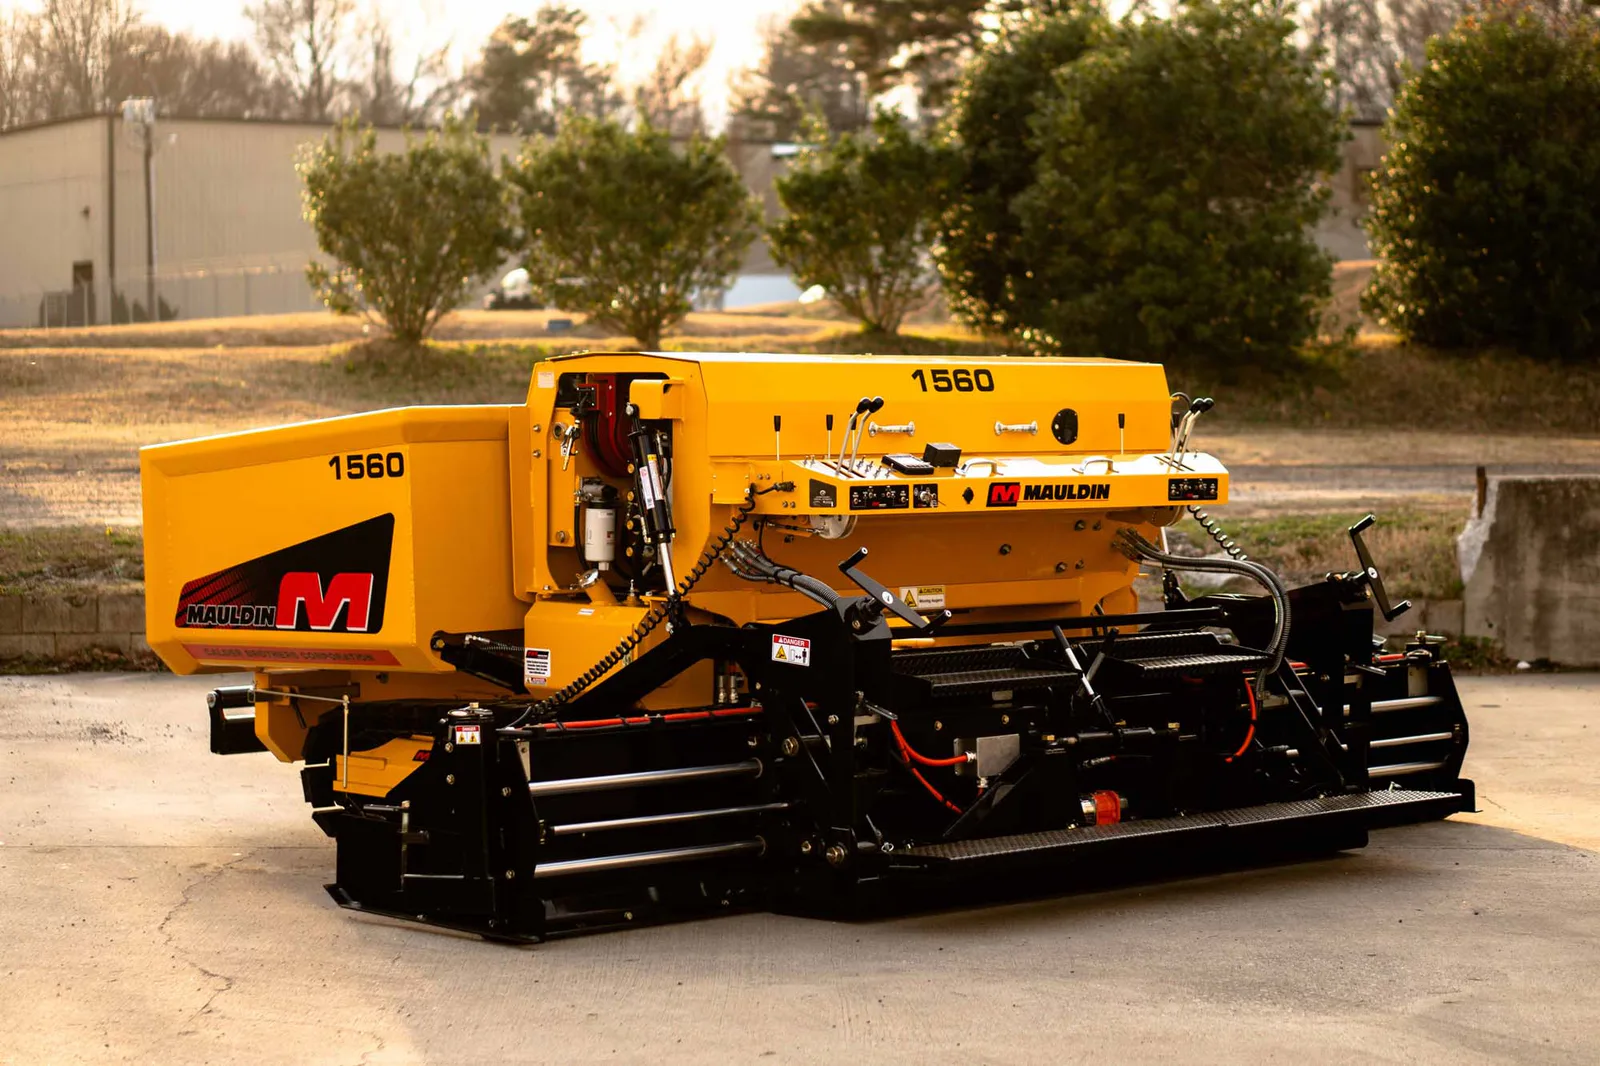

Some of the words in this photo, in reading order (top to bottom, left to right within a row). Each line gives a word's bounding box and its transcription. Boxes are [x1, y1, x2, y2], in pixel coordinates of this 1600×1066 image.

[911, 369, 995, 392] 1560
[328, 452, 405, 480] 1560
[990, 485, 1021, 503] M
[1024, 484, 1110, 500] MAULDIN
[186, 604, 276, 627] MAULDIN
[276, 572, 374, 631] M
[784, 637, 805, 647] DANGER
